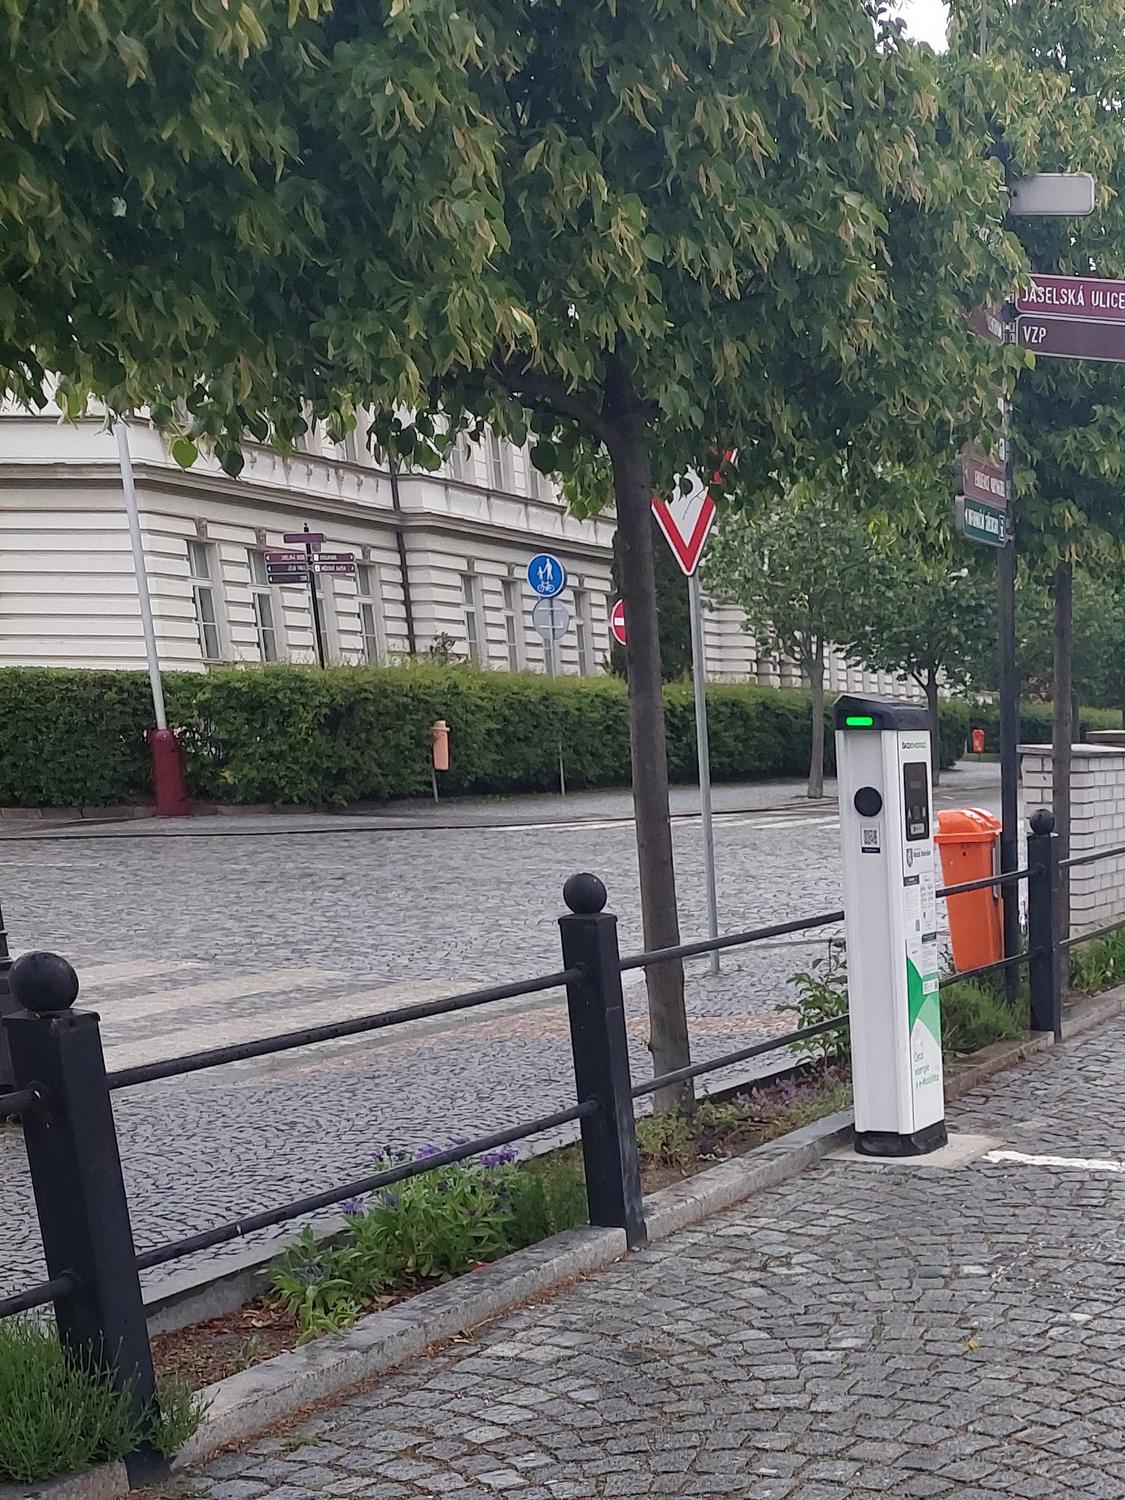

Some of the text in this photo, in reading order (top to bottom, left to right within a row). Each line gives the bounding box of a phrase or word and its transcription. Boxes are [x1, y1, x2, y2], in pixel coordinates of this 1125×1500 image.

[1022, 284, 1125, 309] JASELSKÁ ULICE
[1022, 325, 1047, 344] VZP
